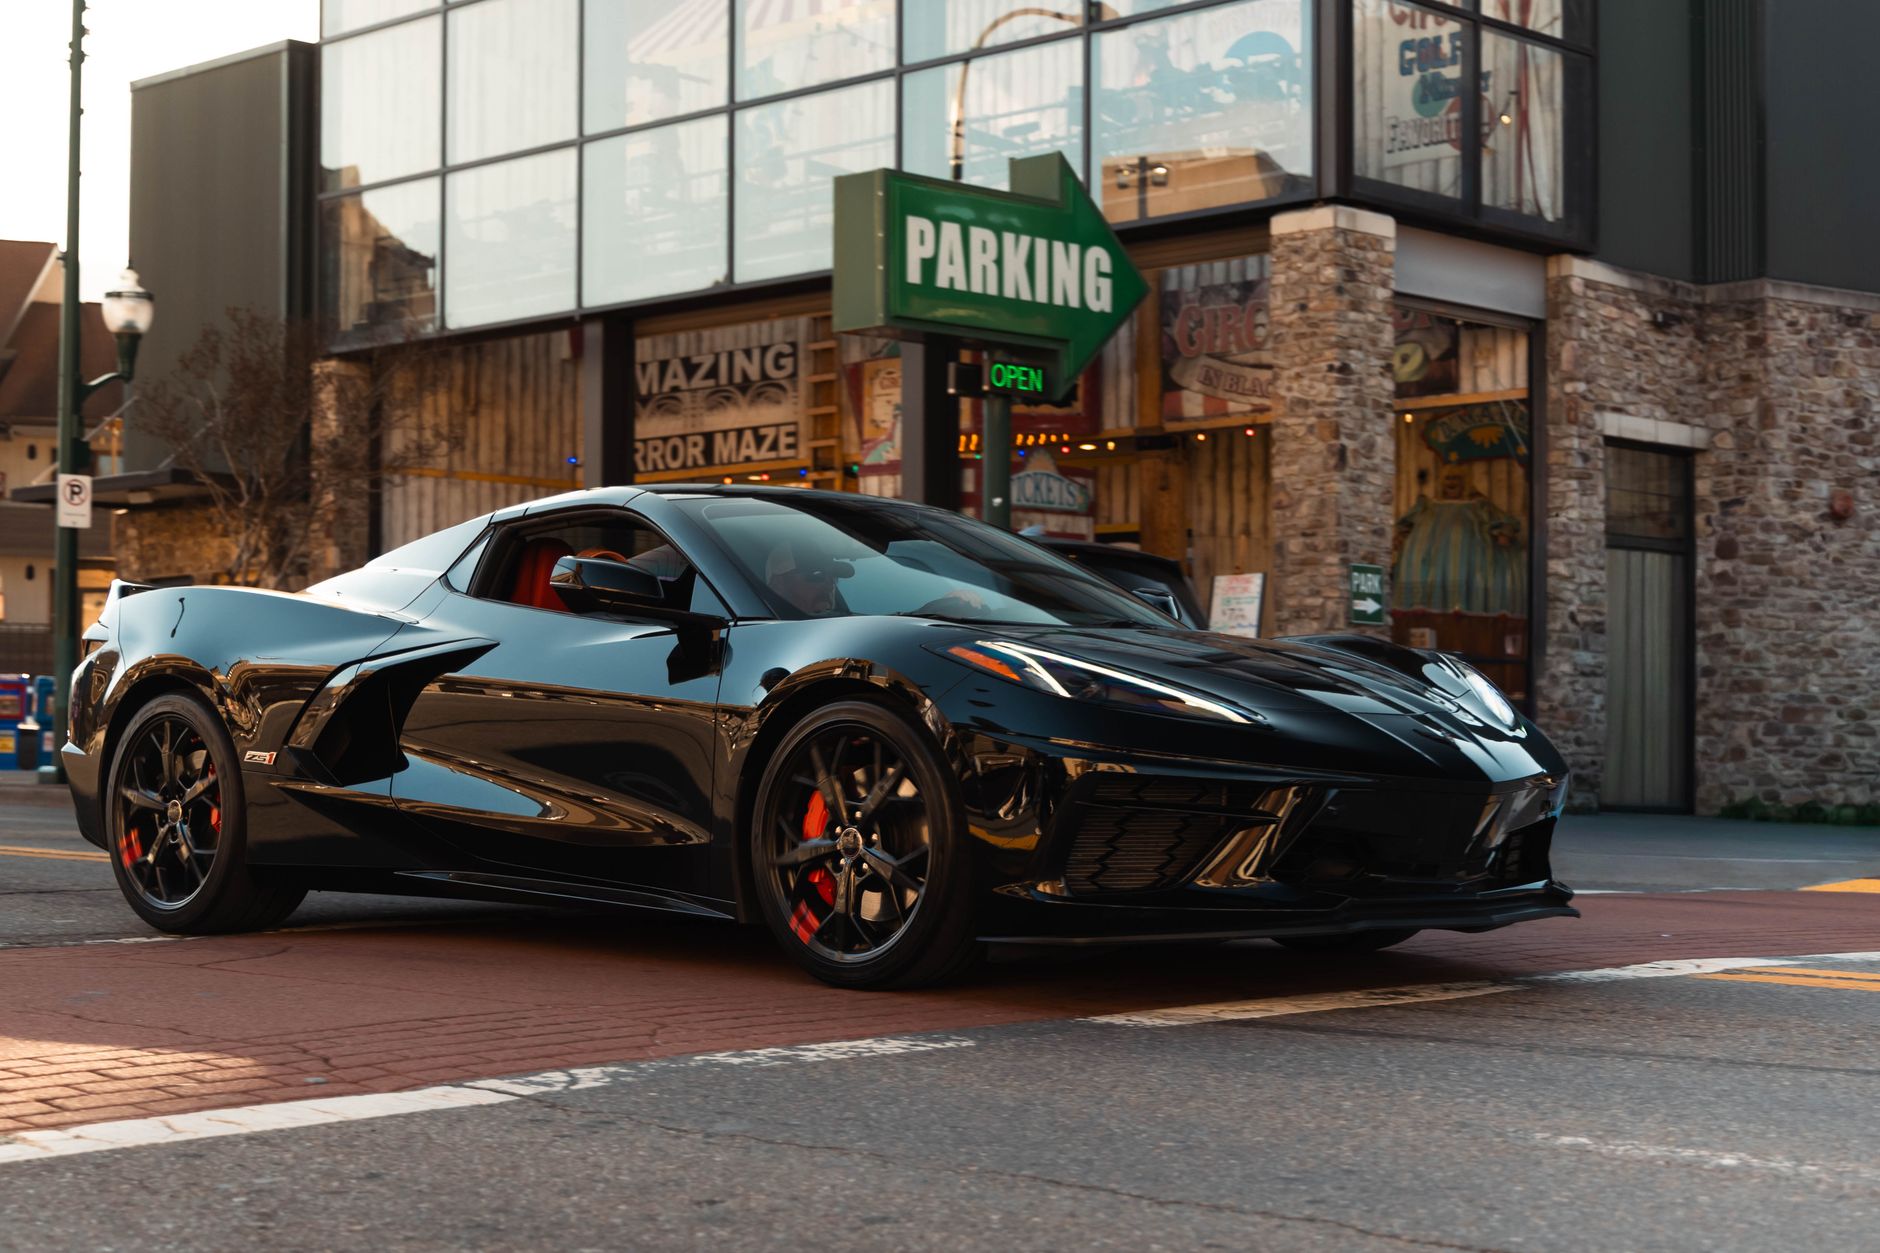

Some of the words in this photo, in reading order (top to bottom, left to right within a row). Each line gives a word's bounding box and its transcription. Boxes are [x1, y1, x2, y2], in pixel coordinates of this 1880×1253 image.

[906, 215, 1113, 313] PARKING
[990, 363, 1043, 392] OPEN
[713, 424, 796, 465] MAZE
[1012, 471, 1077, 507] ICKETS
[1351, 571, 1382, 594] PARK
